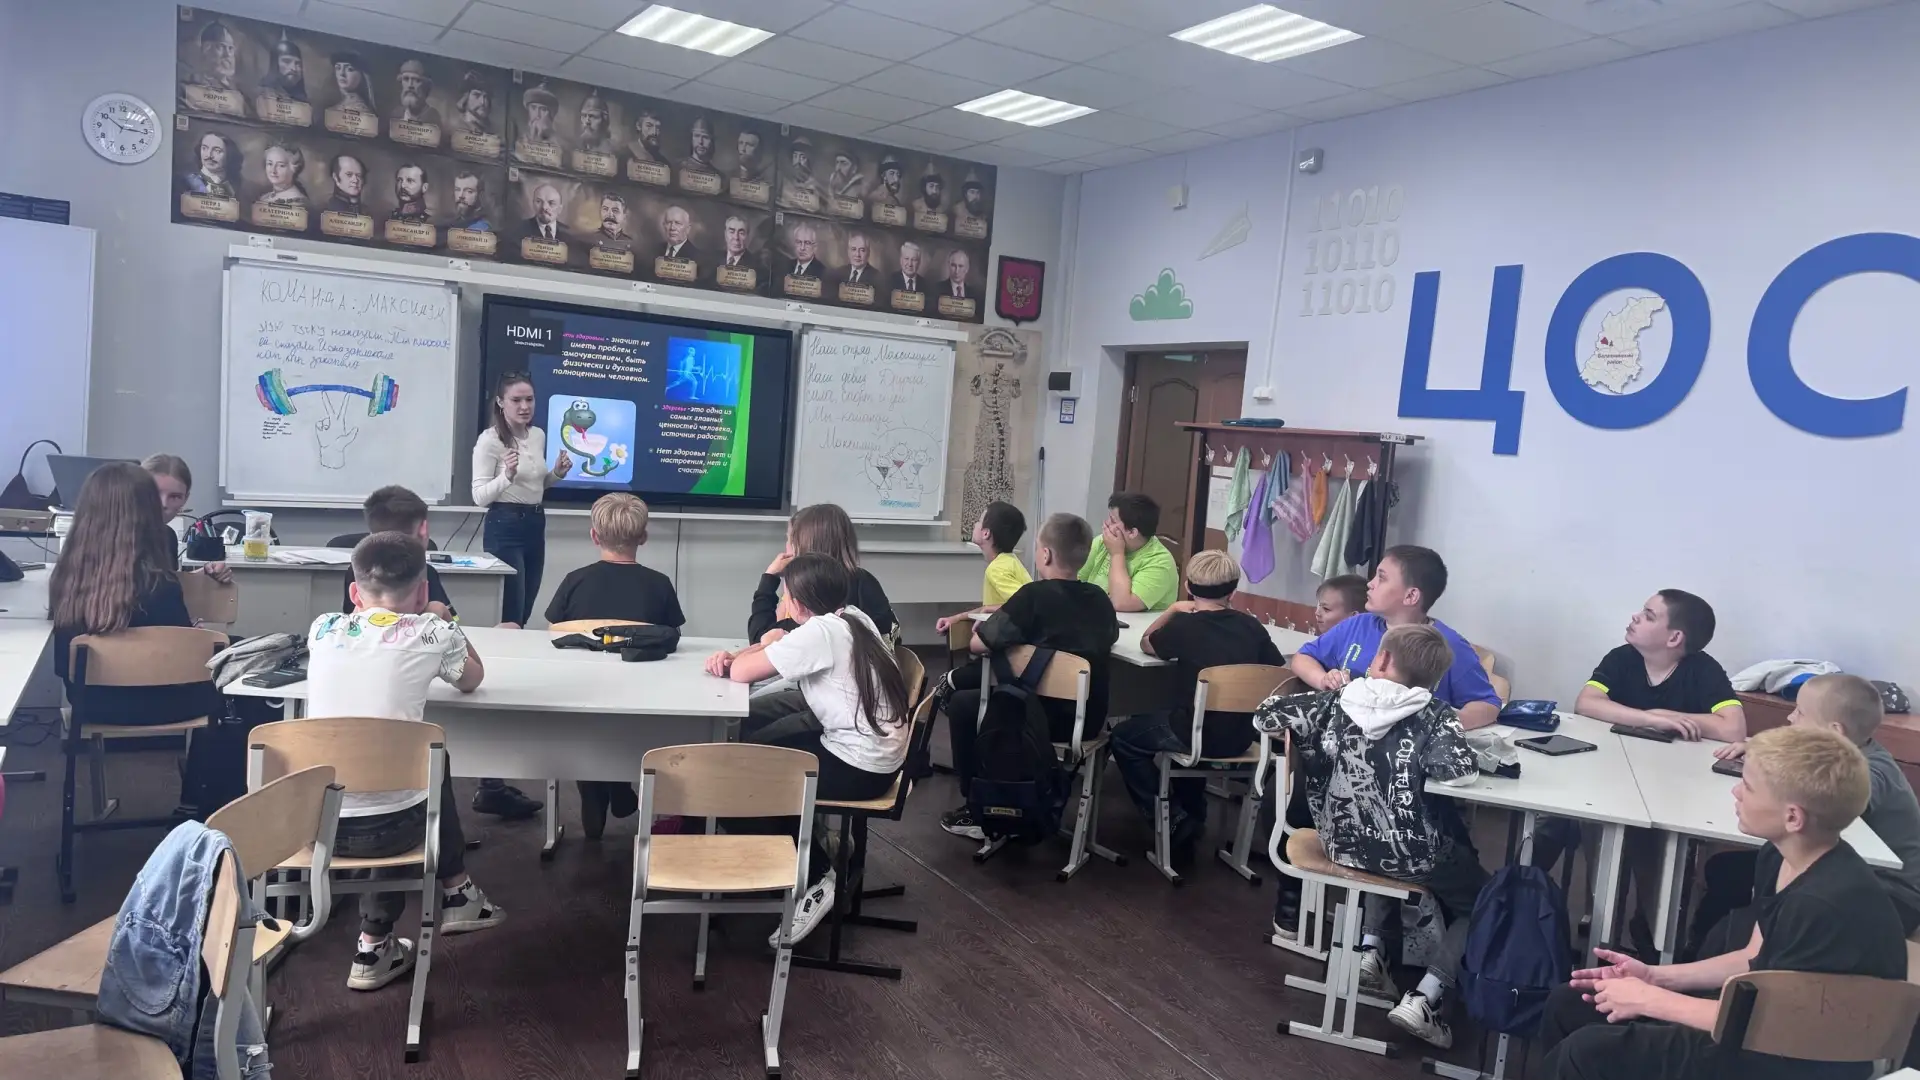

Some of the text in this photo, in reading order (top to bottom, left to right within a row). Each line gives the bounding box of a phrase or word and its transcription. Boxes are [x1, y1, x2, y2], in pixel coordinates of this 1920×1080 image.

[1310, 187, 1403, 232] 11010
[1303, 229, 1399, 274] 10110
[1299, 274, 1396, 317] 11010
[506, 325, 552, 341] HDMI 1
[570, 341, 597, 350] иметь
[598, 344, 631, 354] проблем
[611, 337, 640, 345] значит
[640, 339, 650, 347] не
[625, 355, 647, 365] быть
[562, 359, 604, 369] физически
[611, 363, 643, 373] духовно
[552, 367, 650, 383] полноценным человеком.
[706, 406, 723, 414] одна
[694, 415, 723, 423] главных
[658, 422, 733, 433] ценностей человека,
[661, 431, 729, 441] источник радости.
[656, 447, 672, 455] Нет
[673, 448, 706, 457] здоровья
[660, 457, 705, 466] настроения,
